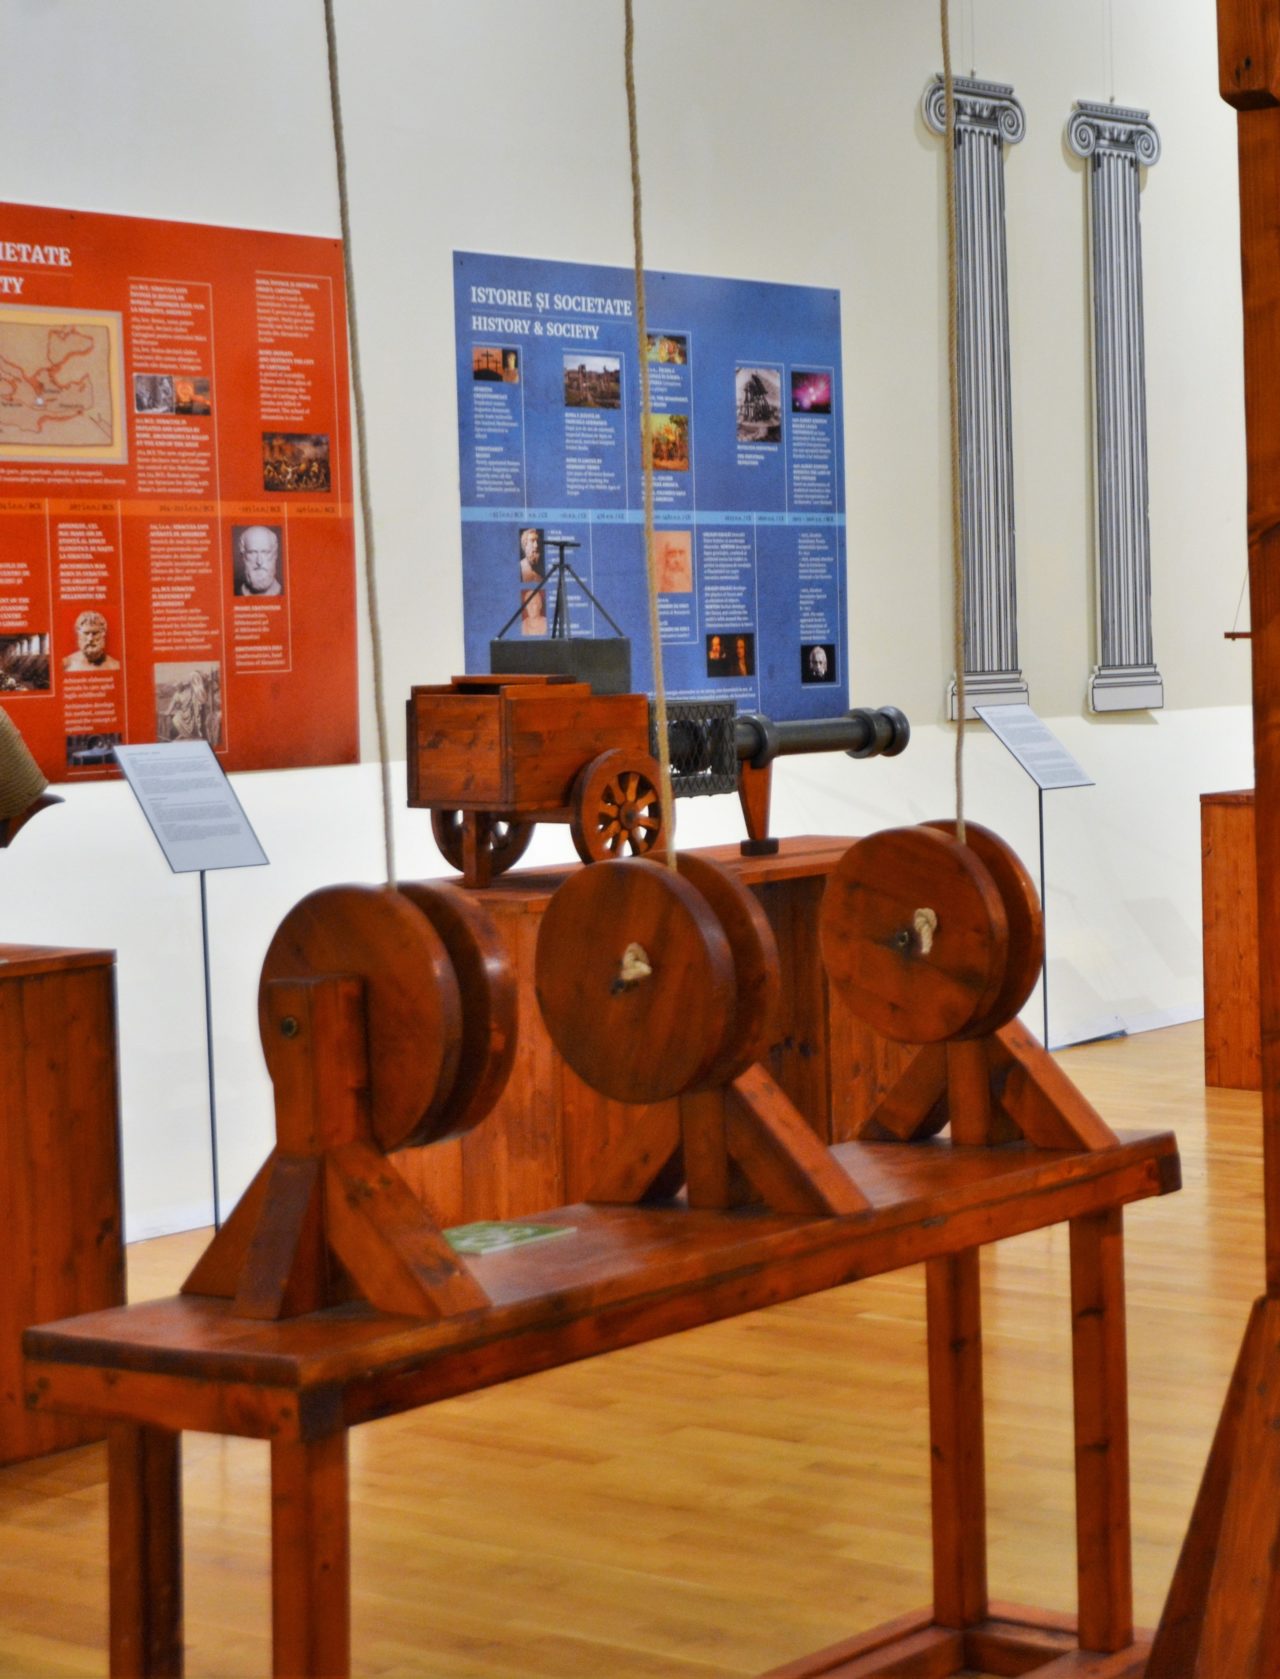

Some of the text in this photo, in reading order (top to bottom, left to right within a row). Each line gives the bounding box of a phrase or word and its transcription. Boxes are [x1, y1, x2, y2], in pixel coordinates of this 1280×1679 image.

[471, 286, 533, 308] ISTORIE
[554, 294, 633, 317] SOCIETATE
[472, 315, 600, 340] HISTORY & SOCIETY
